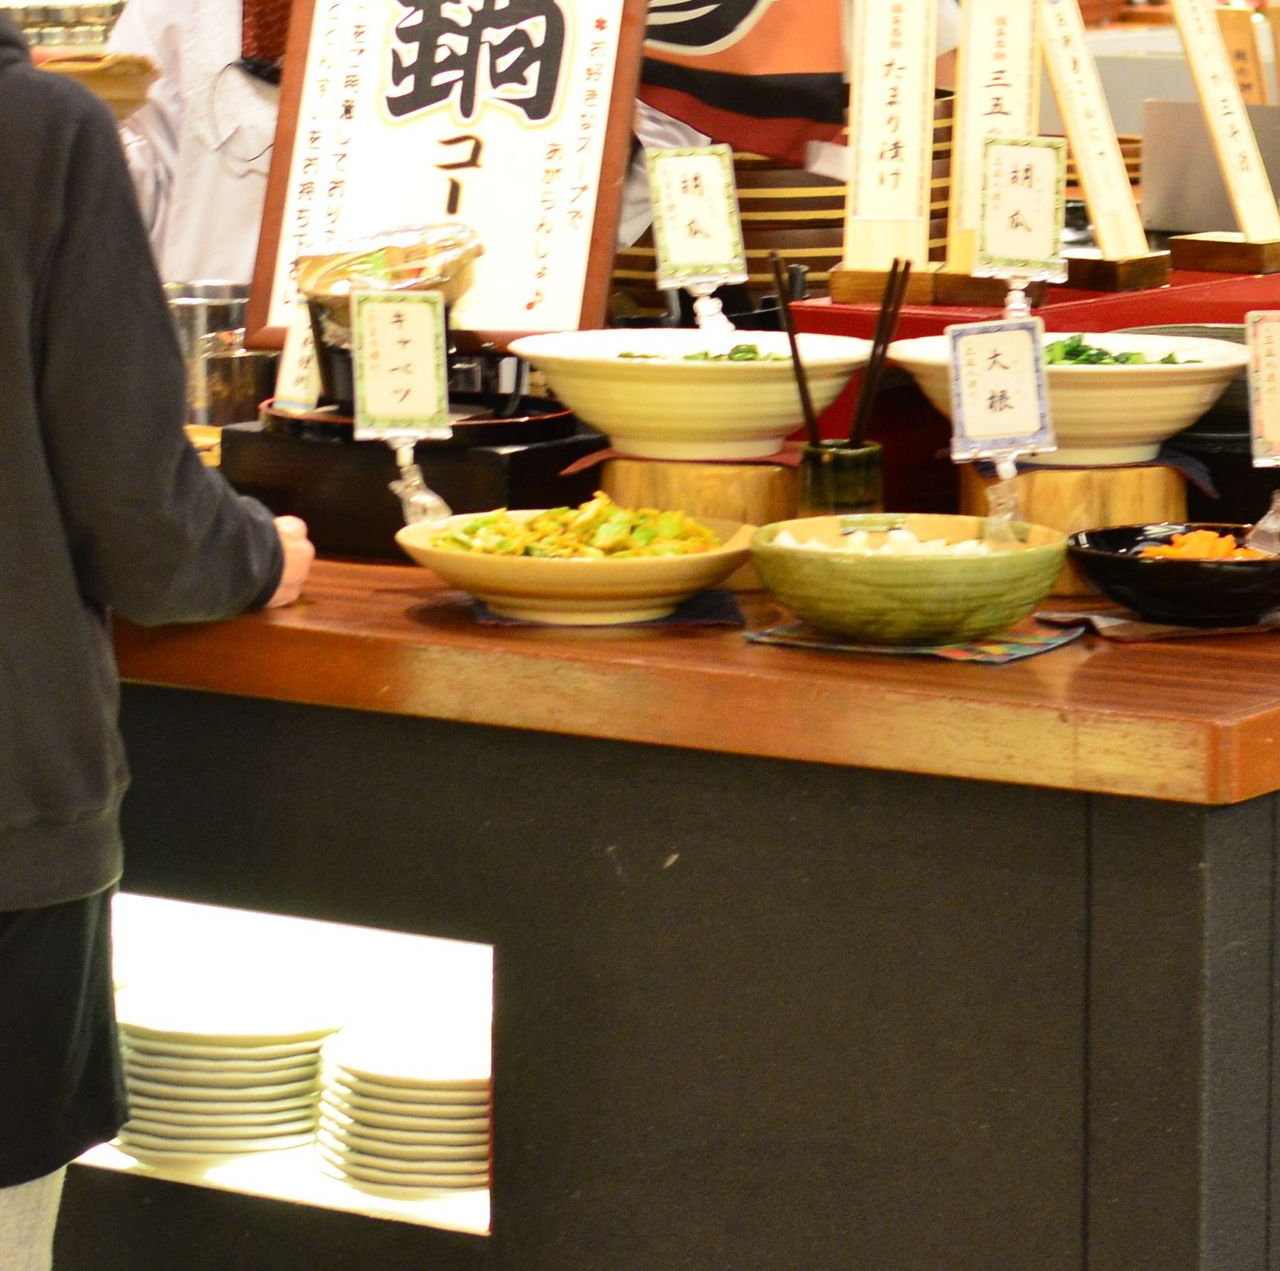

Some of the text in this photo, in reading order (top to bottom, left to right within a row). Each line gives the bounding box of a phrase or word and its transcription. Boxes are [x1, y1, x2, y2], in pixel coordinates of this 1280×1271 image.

[388, 309, 413, 403] キャベツ
[985, 348, 1015, 413] 大根
